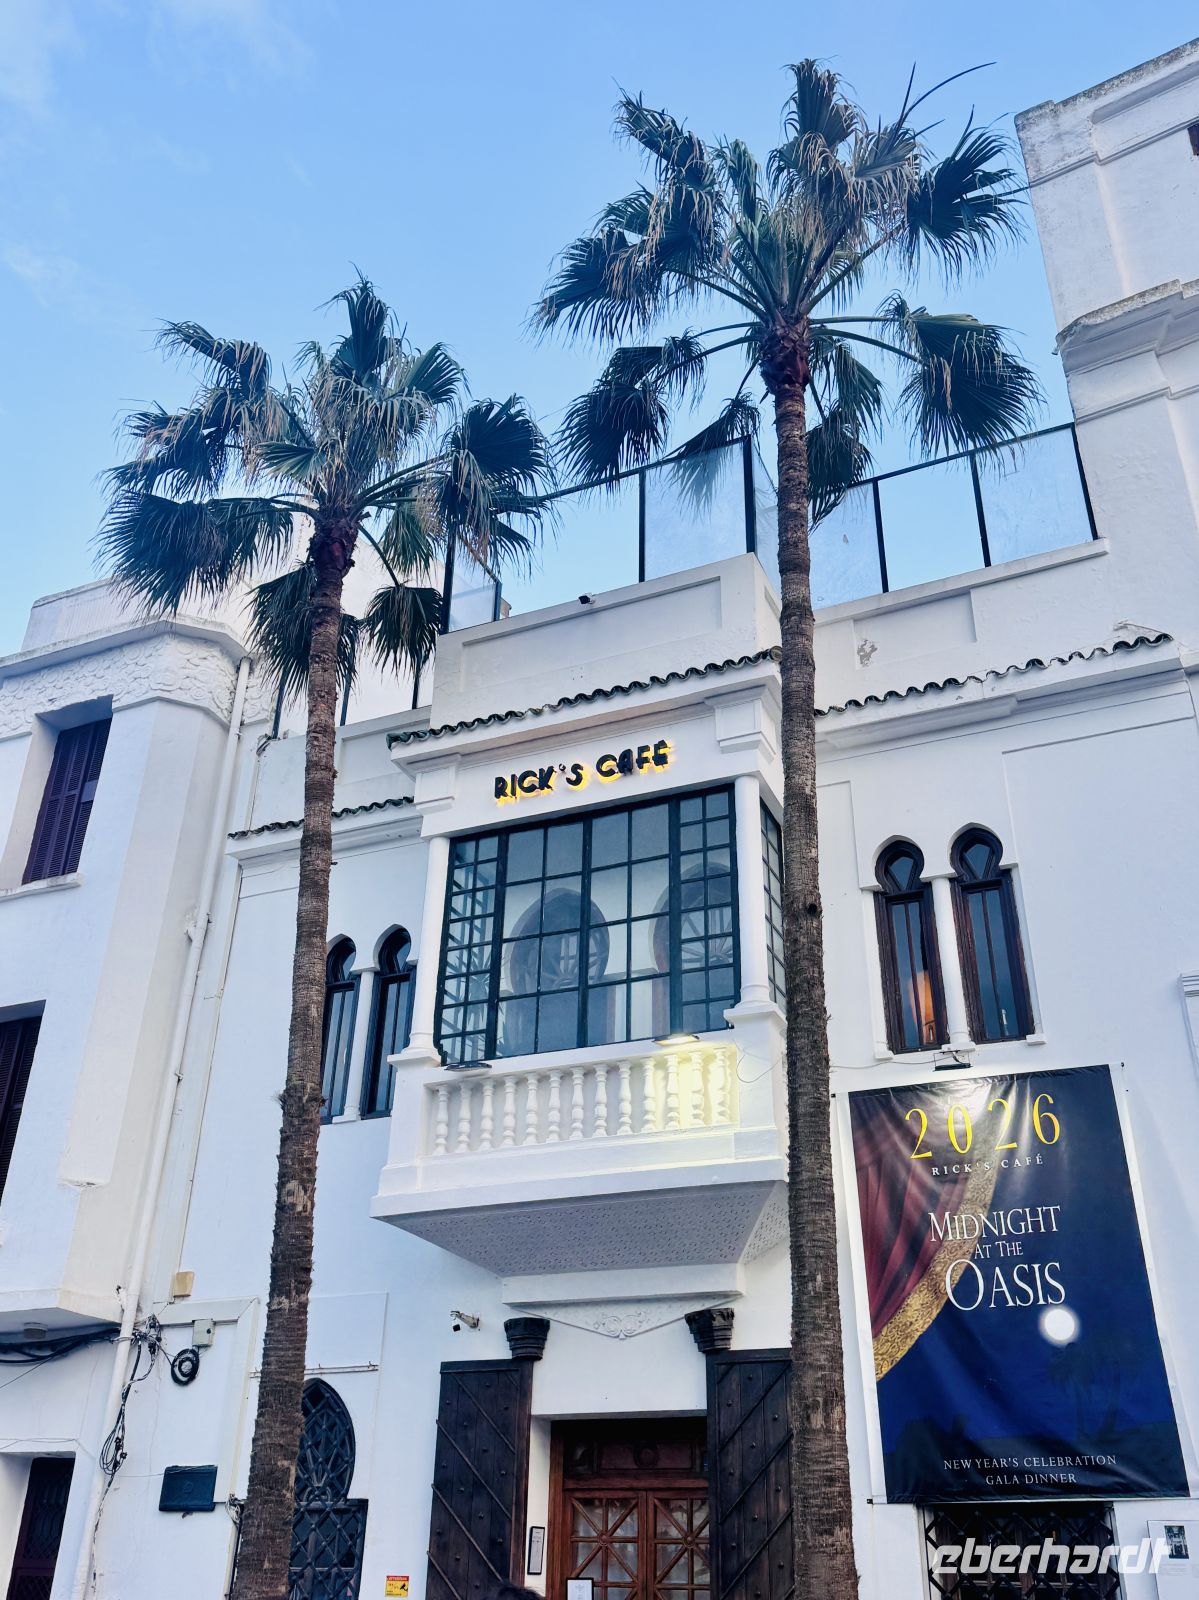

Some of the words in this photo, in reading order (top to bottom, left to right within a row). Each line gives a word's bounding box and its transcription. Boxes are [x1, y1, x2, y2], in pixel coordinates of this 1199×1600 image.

[494, 763, 585, 800] RICK'S
[904, 1094, 1061, 1159] 2026
[931, 1162, 990, 1176] RICK'S
[1001, 1153, 1043, 1168] CAFÉ
[928, 1205, 1061, 1242] MIDNIGHT
[974, 1244, 991, 1260] AT
[995, 1240, 1023, 1256] THE
[945, 1259, 1066, 1311] OASIS
[943, 1459, 972, 1470] NEW
[975, 1457, 1019, 1468] YEAR'S
[1023, 1455, 1118, 1467] CELEBRATION
[985, 1474, 1020, 1485] GALA
[1025, 1473, 1077, 1484] DINNER
